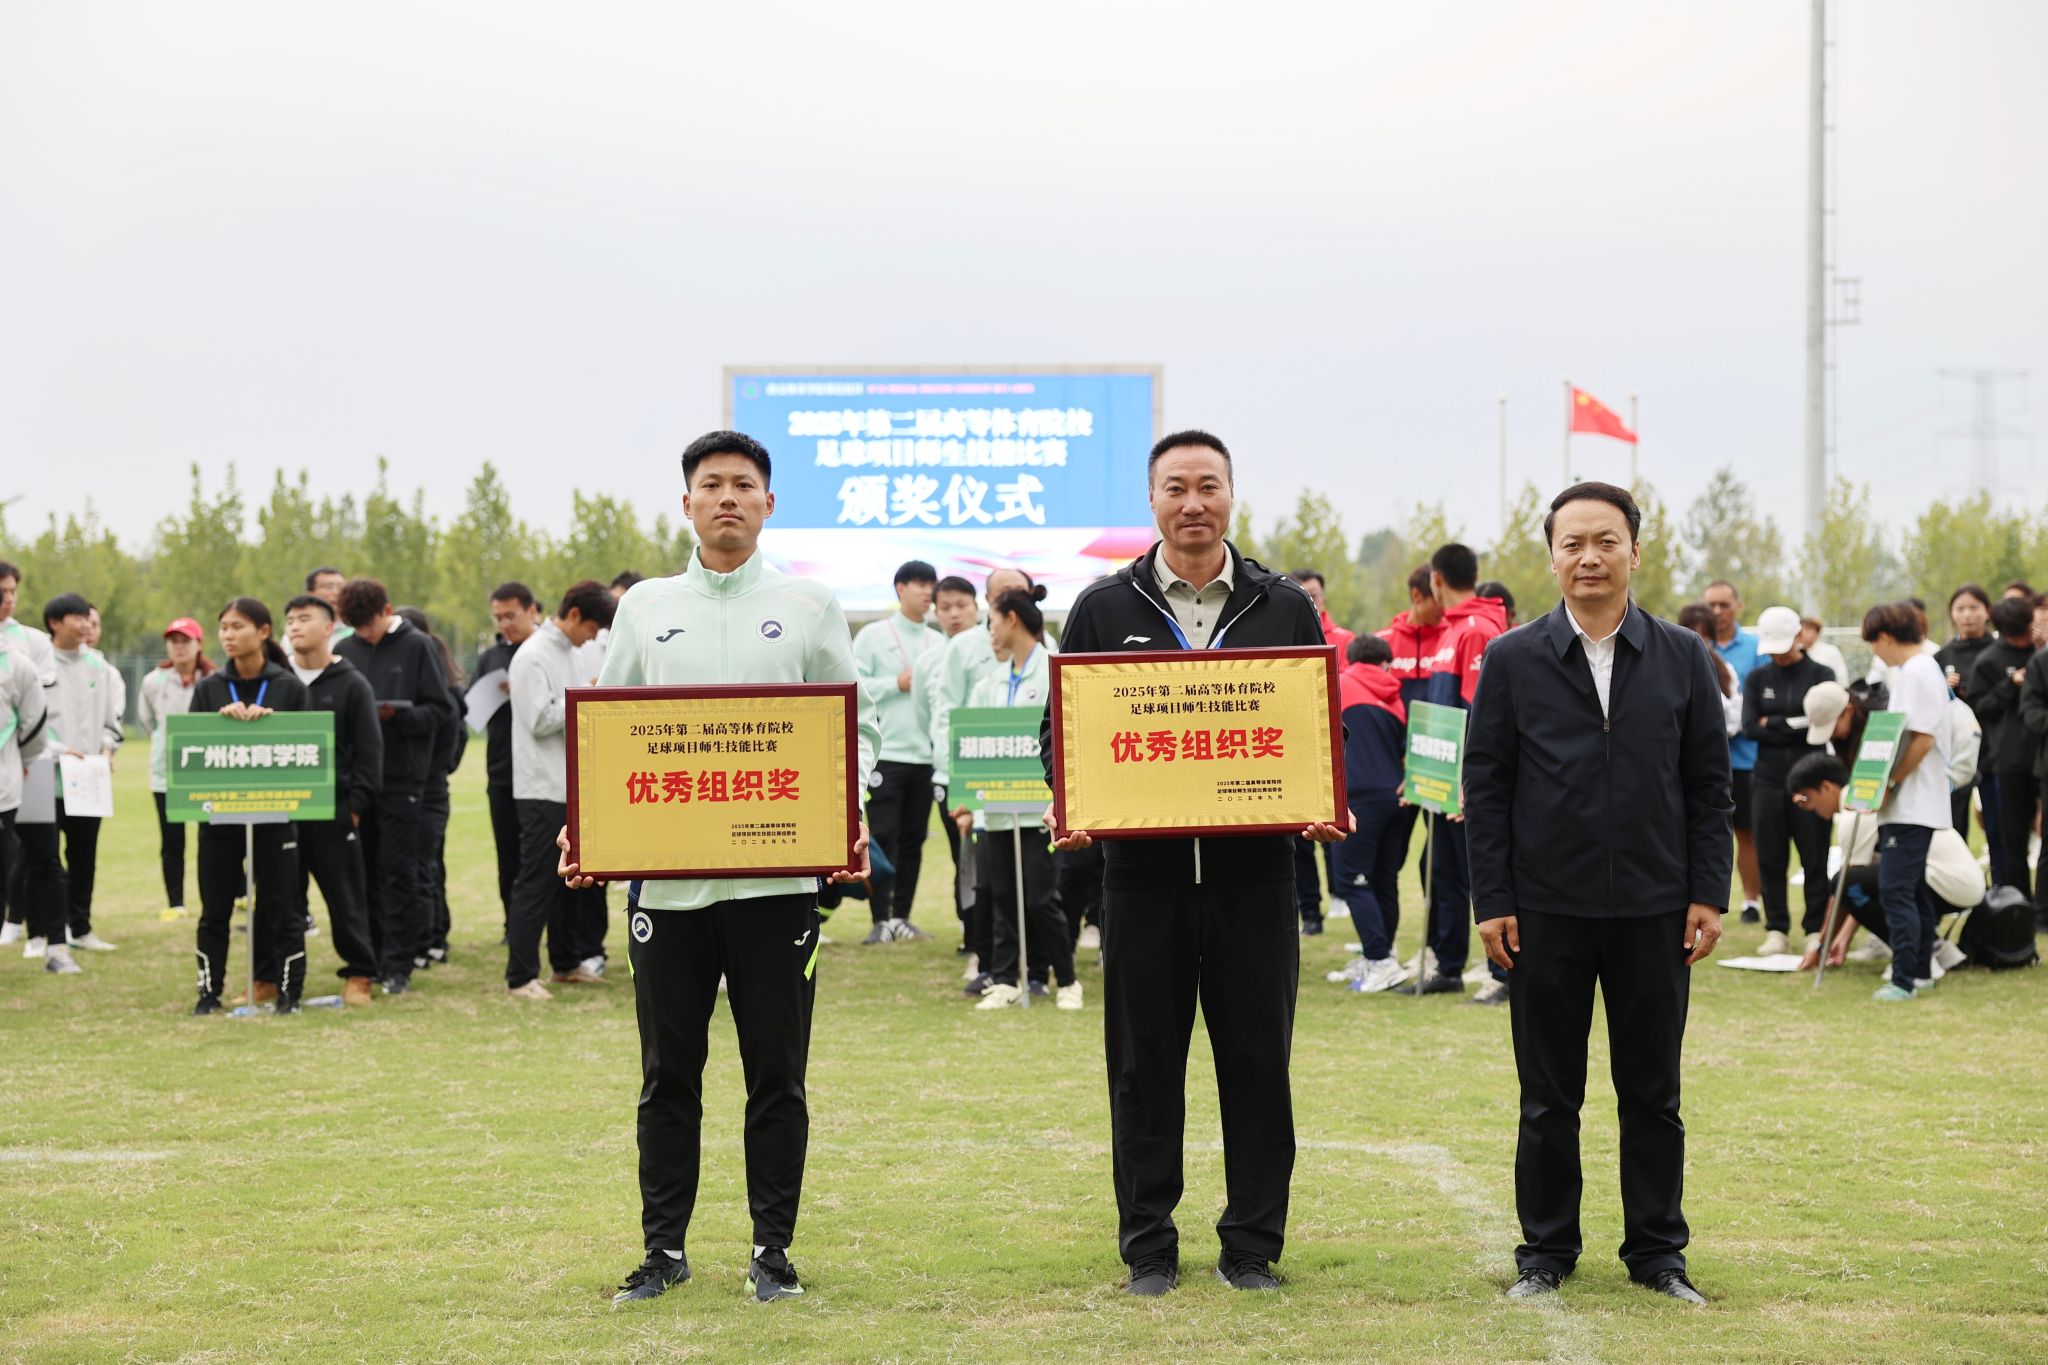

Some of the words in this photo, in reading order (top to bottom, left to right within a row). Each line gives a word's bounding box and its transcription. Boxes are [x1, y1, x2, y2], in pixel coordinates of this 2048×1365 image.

[836, 473, 1046, 527] 颁奖仪式
[1113, 681, 1276, 699] 2025年第二届高等体育院校
[1130, 699, 1260, 715] 足球项目师生技能比赛
[630, 720, 794, 737] 2025年第二届高等体育院校
[180, 743, 320, 768] 广州体育学院
[647, 739, 778, 755] 足球项目师生技能比赛
[1110, 727, 1285, 764] 优秀组织奖
[625, 768, 801, 805] 优秀组织奖
